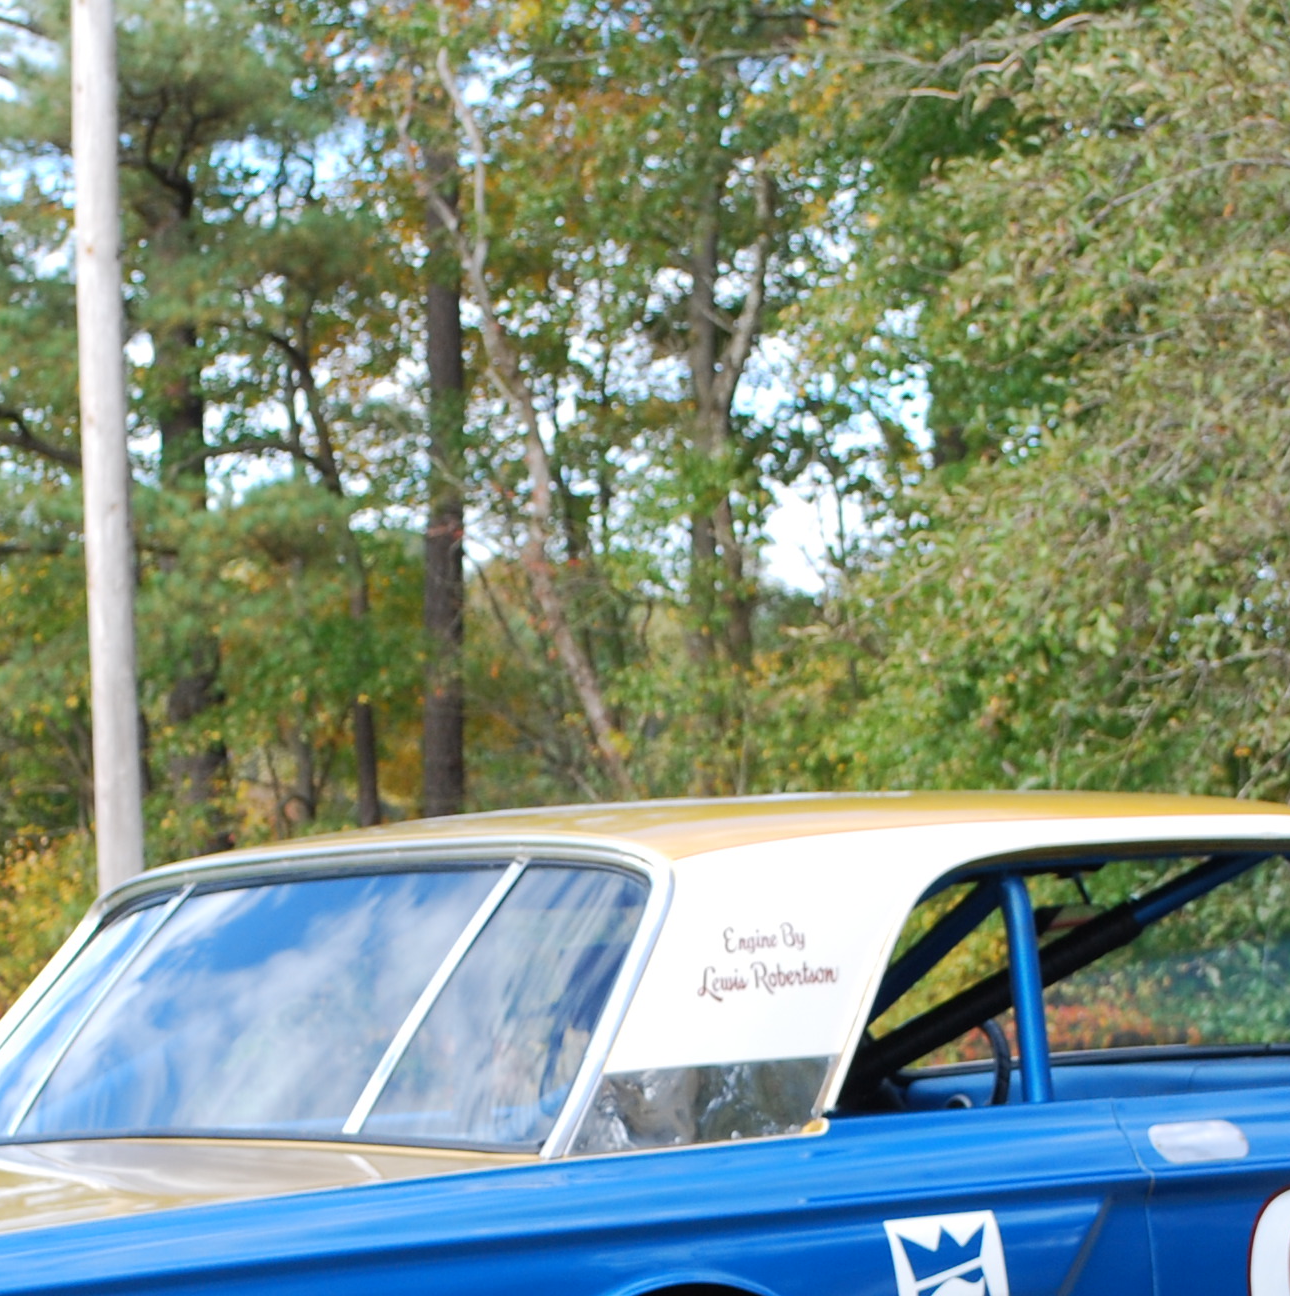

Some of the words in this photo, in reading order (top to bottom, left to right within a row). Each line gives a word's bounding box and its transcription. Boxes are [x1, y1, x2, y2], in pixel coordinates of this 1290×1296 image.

[722, 925, 778, 954] Engine
[779, 921, 806, 951] By
[697, 966, 749, 1003] Lewis
[750, 960, 839, 996] Robertson
